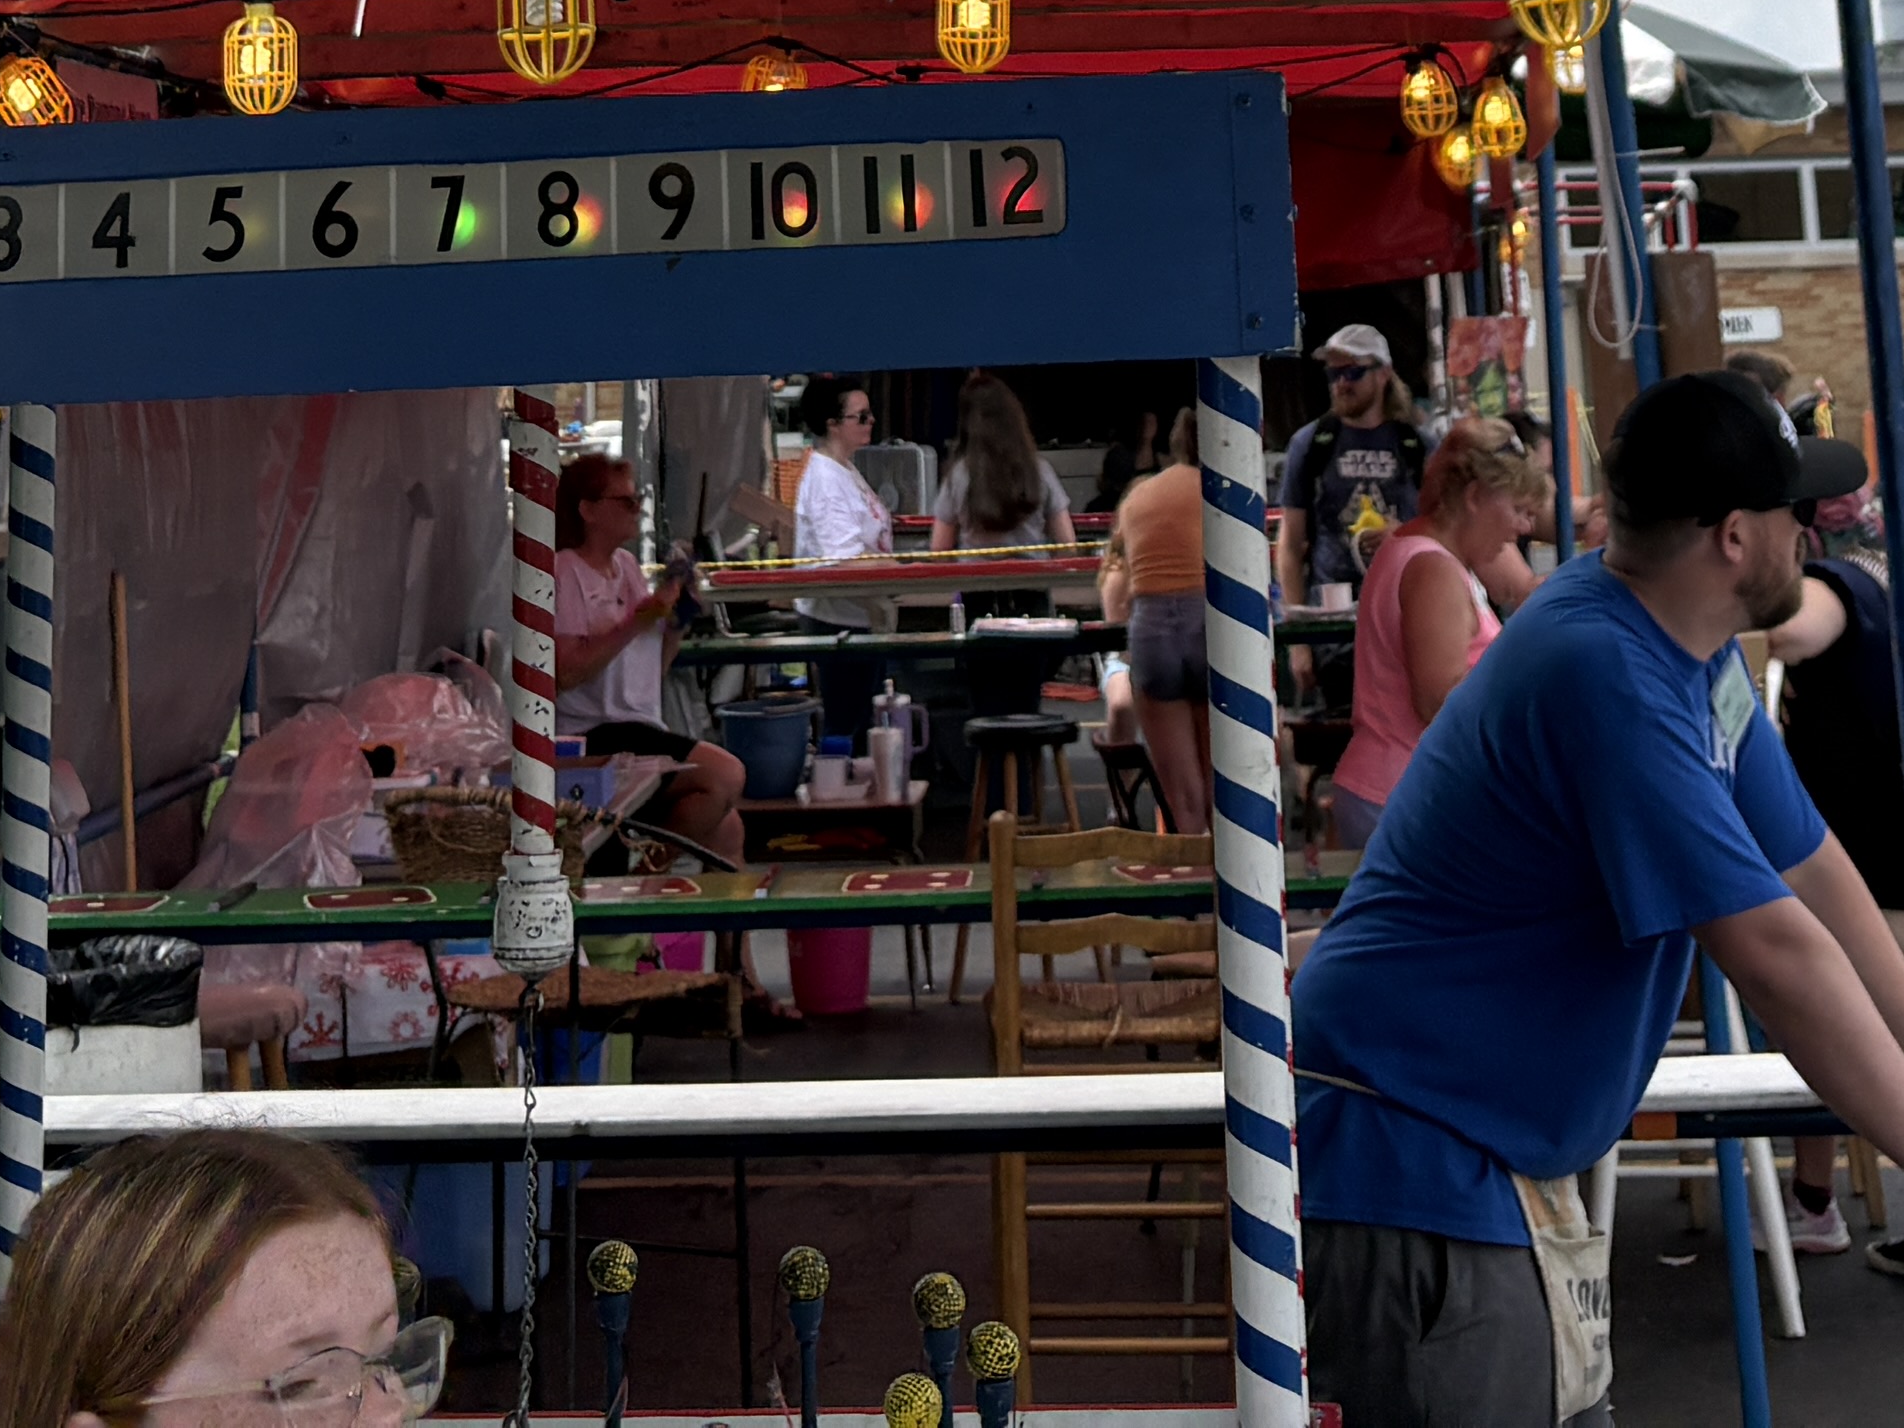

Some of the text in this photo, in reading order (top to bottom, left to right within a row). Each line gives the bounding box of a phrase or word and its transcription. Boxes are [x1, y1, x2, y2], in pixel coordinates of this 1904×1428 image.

[91, 192, 136, 269] 4
[202, 185, 245, 262] 5
[312, 180, 359, 258] 6
[431, 175, 466, 252] 7
[537, 170, 580, 247] 8
[648, 162, 695, 240] 9
[750, 161, 818, 241] 10
[863, 153, 918, 235] 11
[969, 146, 1045, 228] 12
